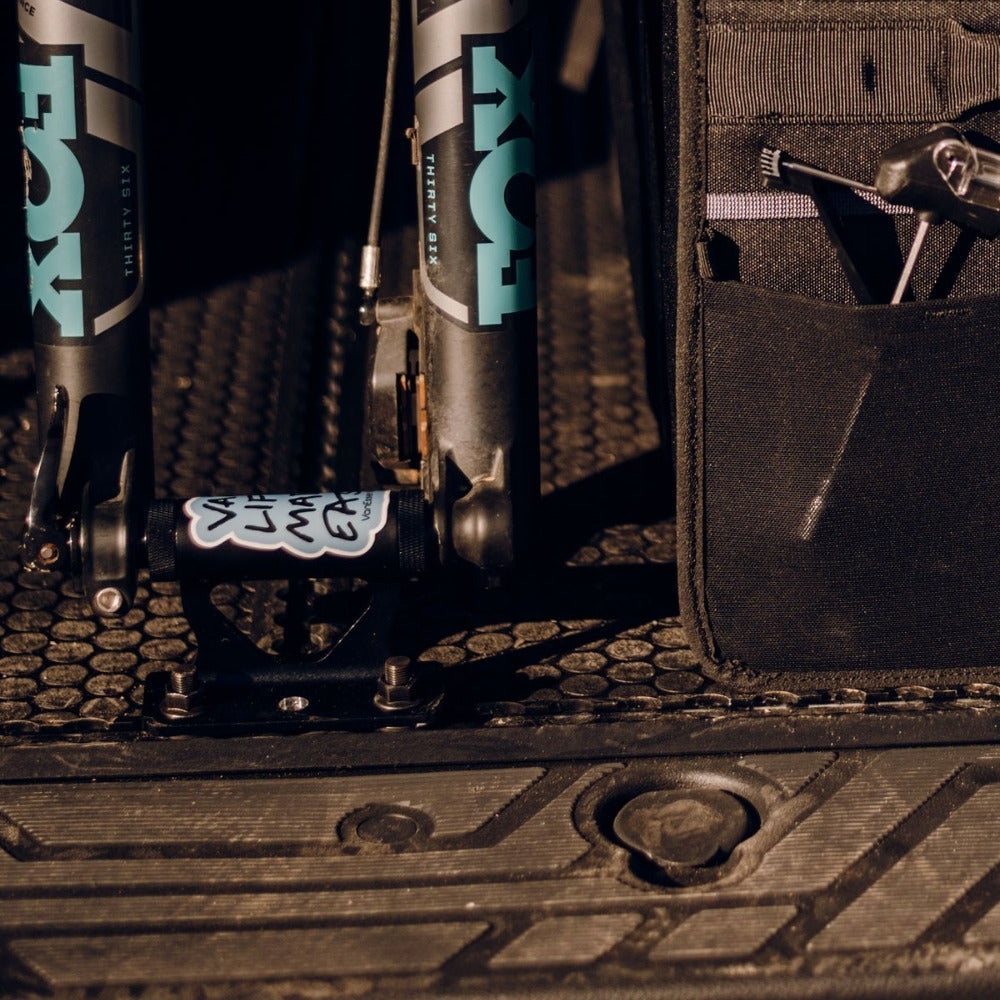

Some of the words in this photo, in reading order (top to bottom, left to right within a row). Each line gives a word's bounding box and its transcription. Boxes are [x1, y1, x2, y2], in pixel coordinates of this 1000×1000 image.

[120, 163, 132, 198] SIX
[426, 153, 438, 224] THIRTY
[122, 207, 135, 278] THIRTY
[428, 232, 438, 266] SIX
[202, 495, 238, 532] VA
[286, 493, 323, 543] MA
